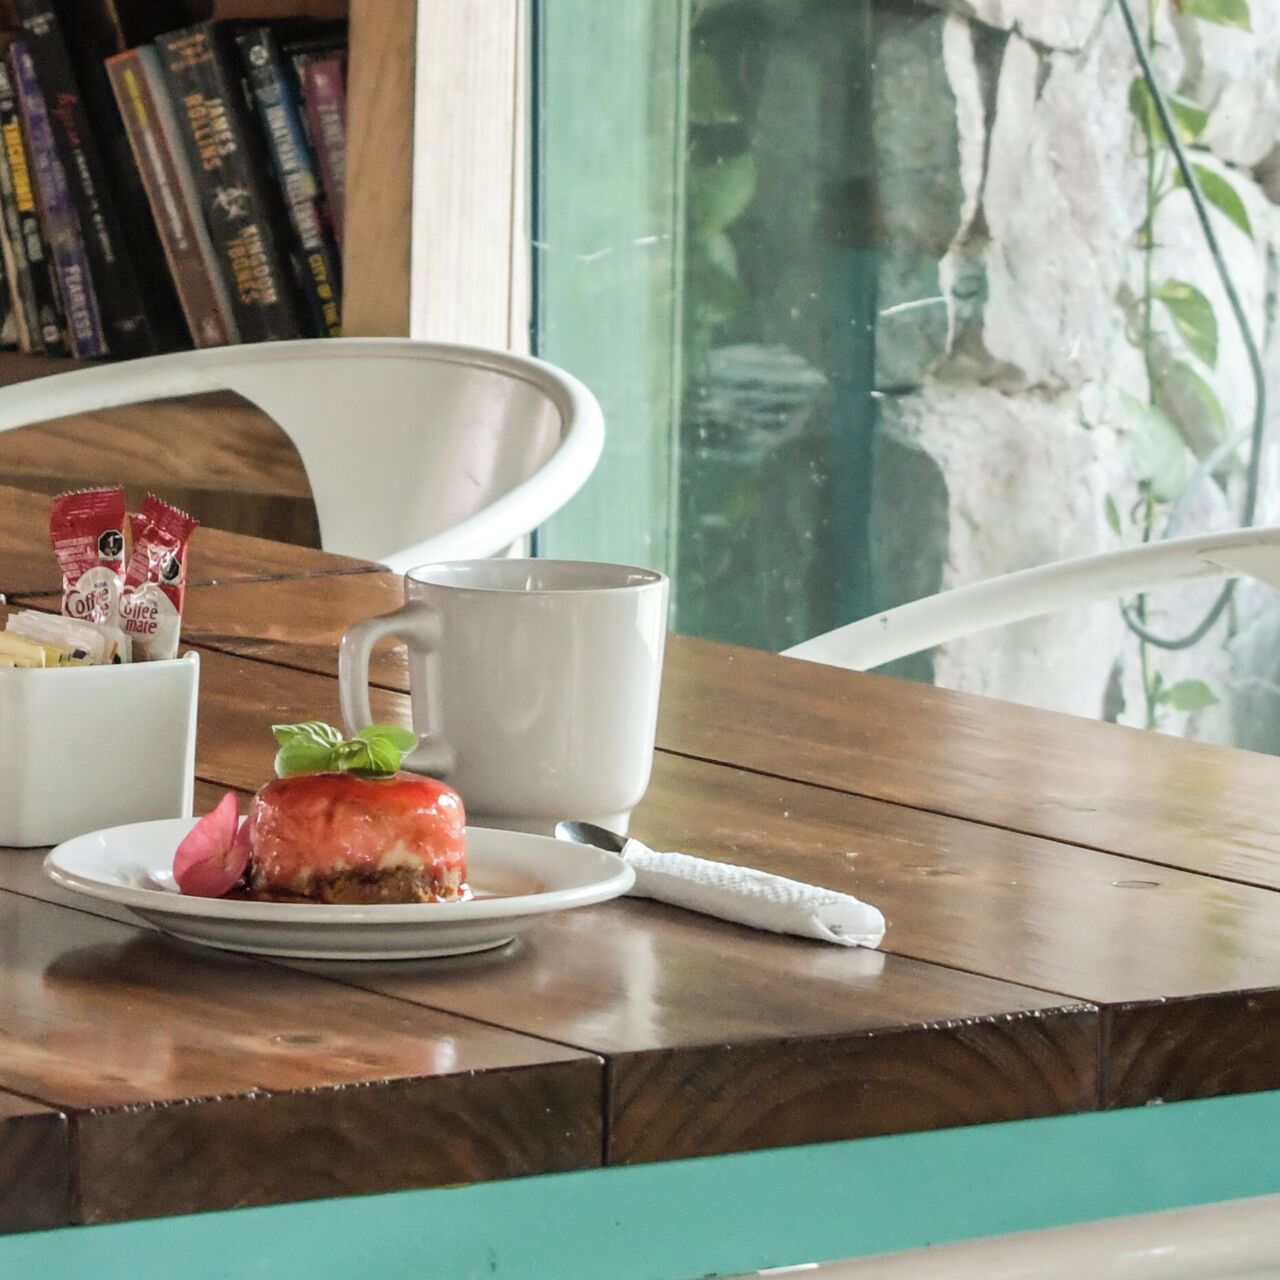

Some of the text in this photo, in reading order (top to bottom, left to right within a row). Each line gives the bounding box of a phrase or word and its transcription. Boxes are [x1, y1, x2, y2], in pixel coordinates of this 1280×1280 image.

[183, 89, 223, 173] ROLLINS
[203, 94, 238, 156] JAMES
[60, 262, 94, 341] FEARLESS
[125, 618, 158, 635] mate
